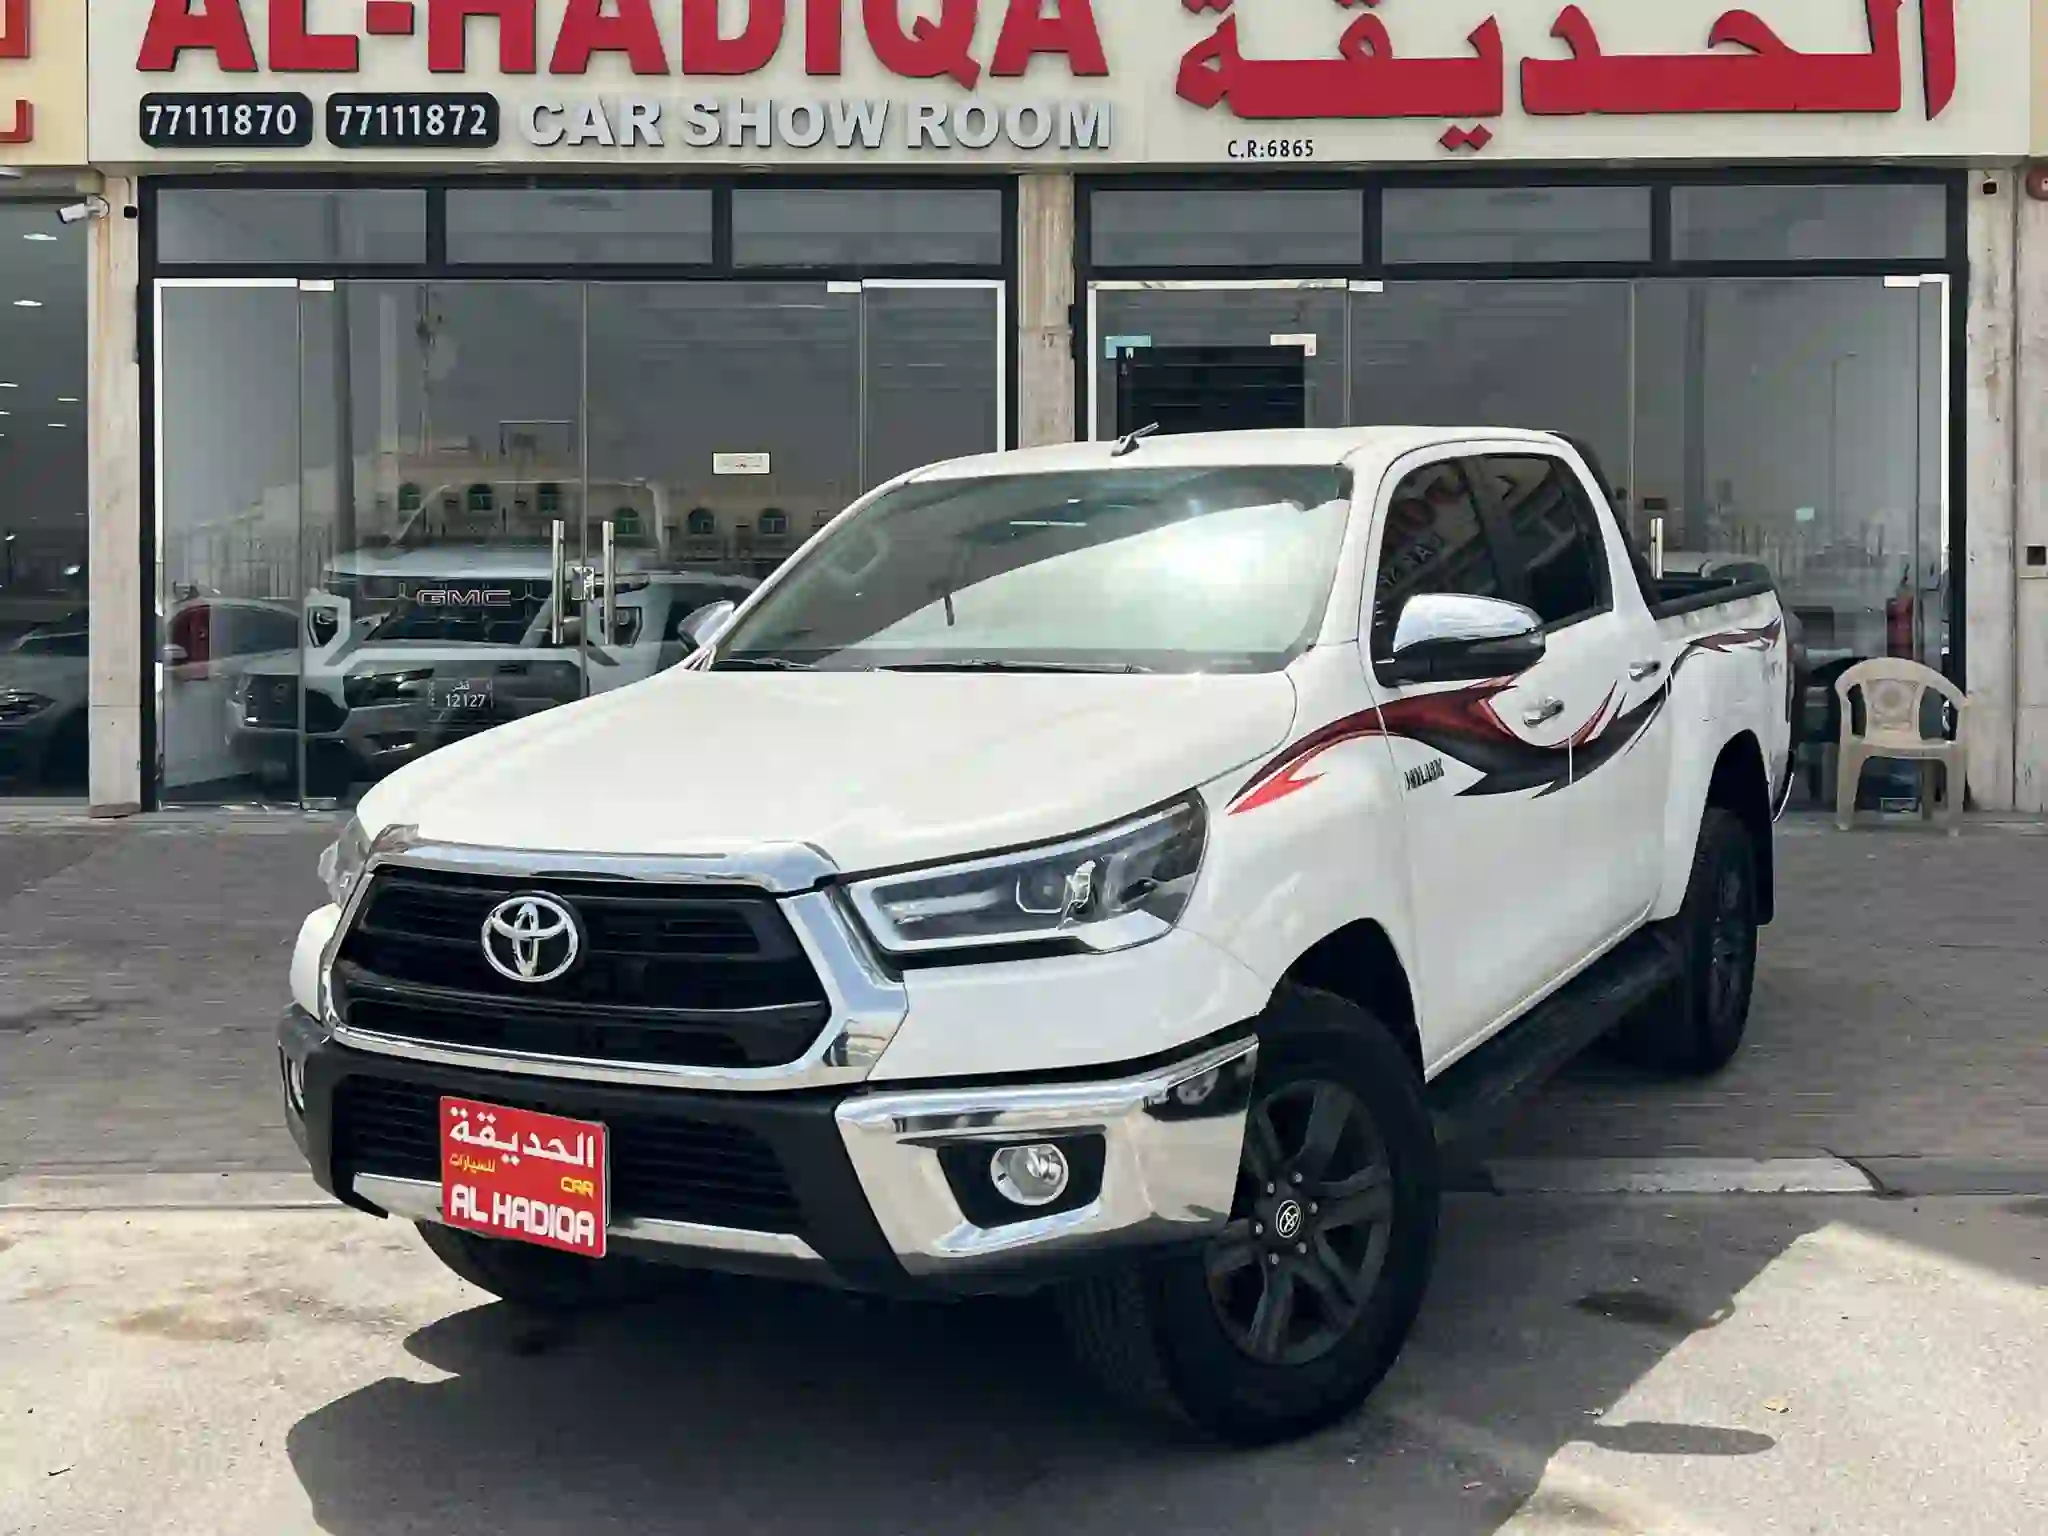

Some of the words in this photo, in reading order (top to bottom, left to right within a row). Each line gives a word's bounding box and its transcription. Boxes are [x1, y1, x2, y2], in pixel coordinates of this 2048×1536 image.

[1176, 0, 1958, 151] الحديقة
[147, 105, 297, 136] 77111870
[335, 104, 488, 137] 77111872
[530, 99, 663, 147] CAR
[684, 98, 889, 148] SHOW
[907, 98, 1112, 149] ROOM
[1227, 139, 1314, 158] C.R:6865
[416, 589, 512, 607] GMC
[448, 1106, 594, 1168] الحديقة
[561, 1177, 594, 1198] CAR
[450, 1183, 489, 1223] AL
[493, 1191, 596, 1247] HADIQA
